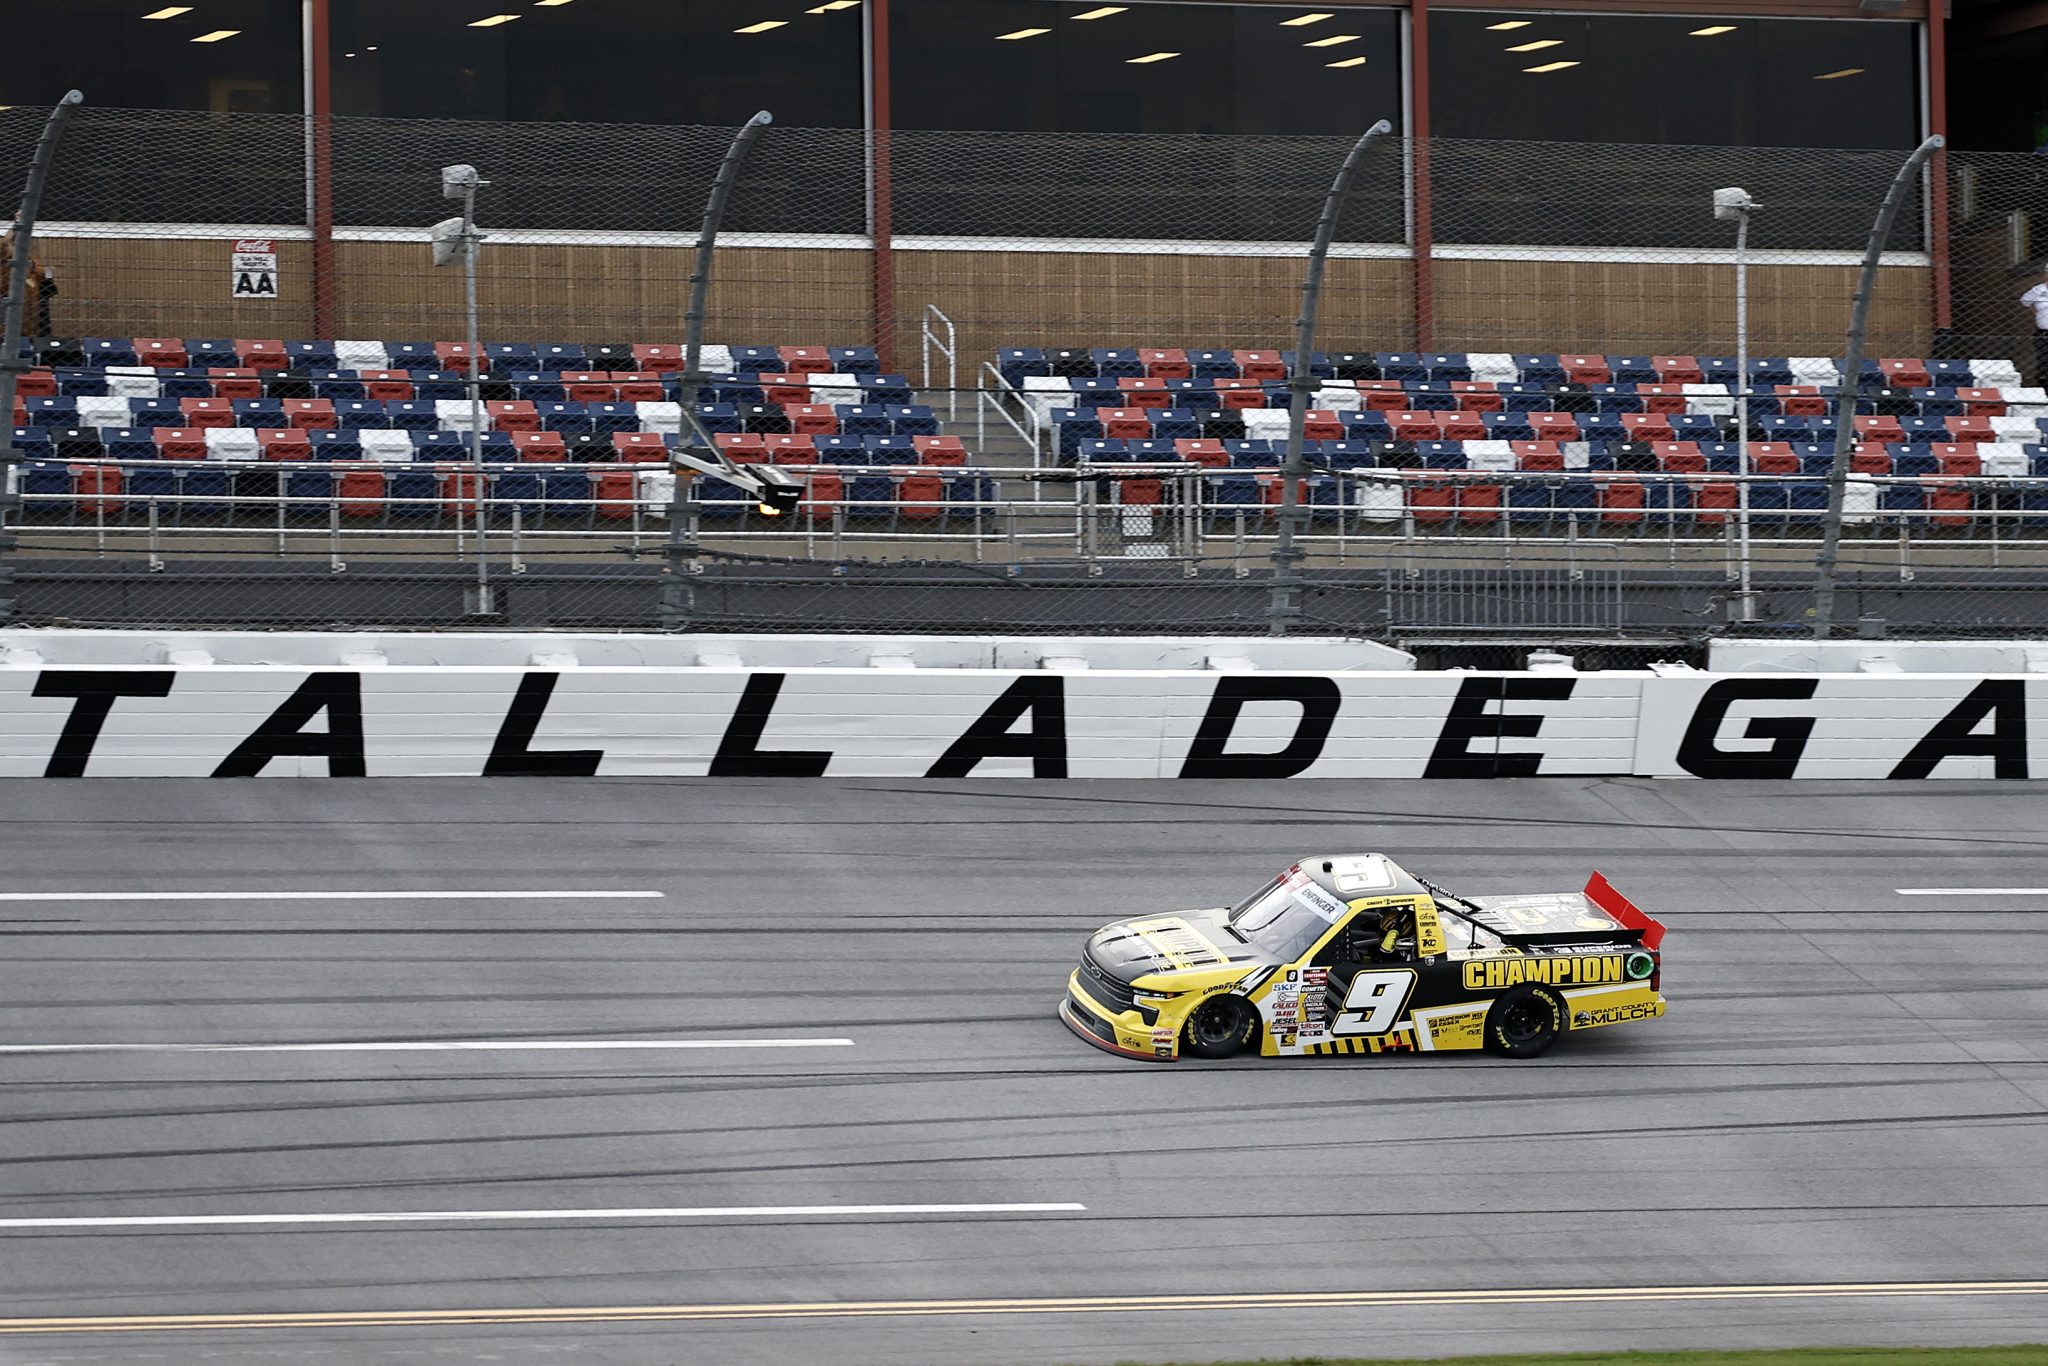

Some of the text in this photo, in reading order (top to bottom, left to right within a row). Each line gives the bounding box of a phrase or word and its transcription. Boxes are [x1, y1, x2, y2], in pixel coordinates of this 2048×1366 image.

[236, 273, 275, 294] AA
[30, 671, 2030, 779] TALLADEGA
[1301, 888, 1336, 914] ENFINGER
[1288, 971, 1296, 981] 8
[1465, 956, 1622, 988] CHAMPION
[1203, 982, 1248, 995] GOODYEAR
[1273, 984, 1298, 992] SKF
[1331, 969, 1416, 1037] 9
[1591, 1001, 1656, 1015] GRANT COUNTY
[1591, 1006, 1657, 1025] MULCH
